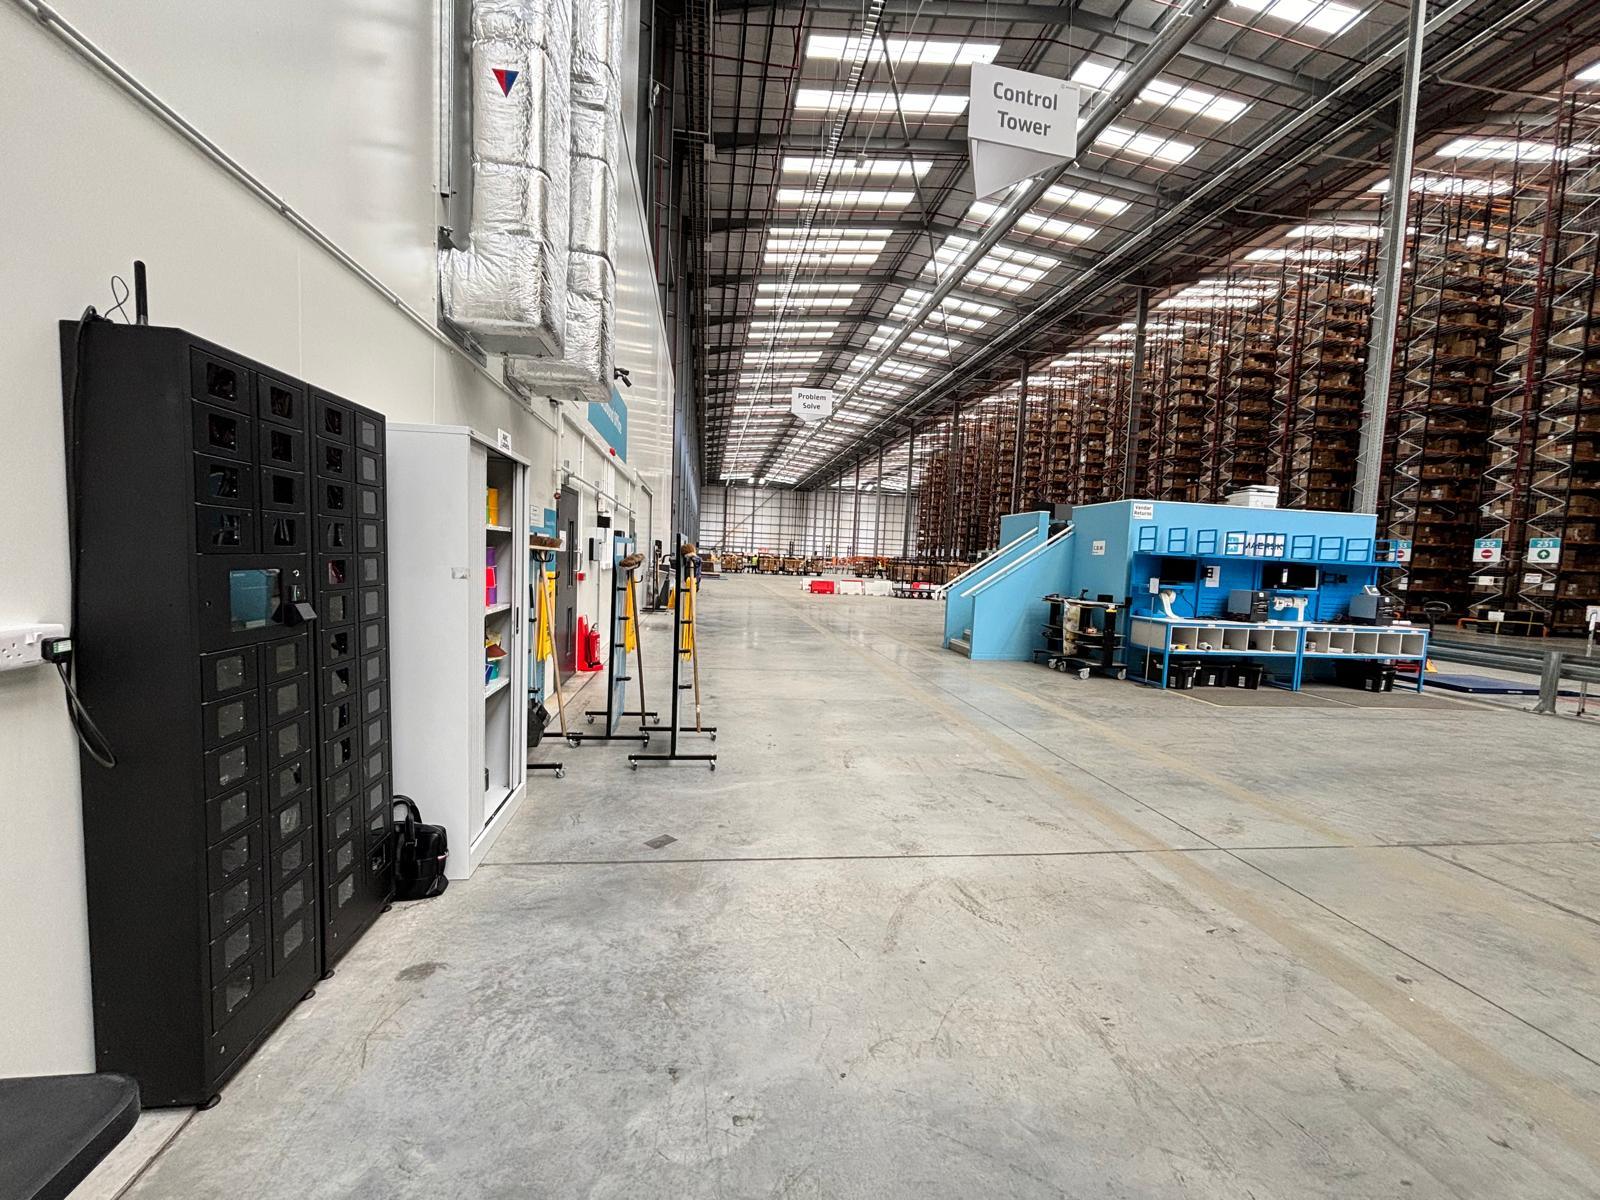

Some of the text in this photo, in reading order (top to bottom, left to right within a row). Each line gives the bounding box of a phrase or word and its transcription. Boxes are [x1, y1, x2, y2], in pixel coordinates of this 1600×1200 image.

[993, 81, 1058, 111] Control
[997, 110, 1051, 136] Tower
[798, 393, 827, 401] Problem
[802, 402, 821, 410] Solve
